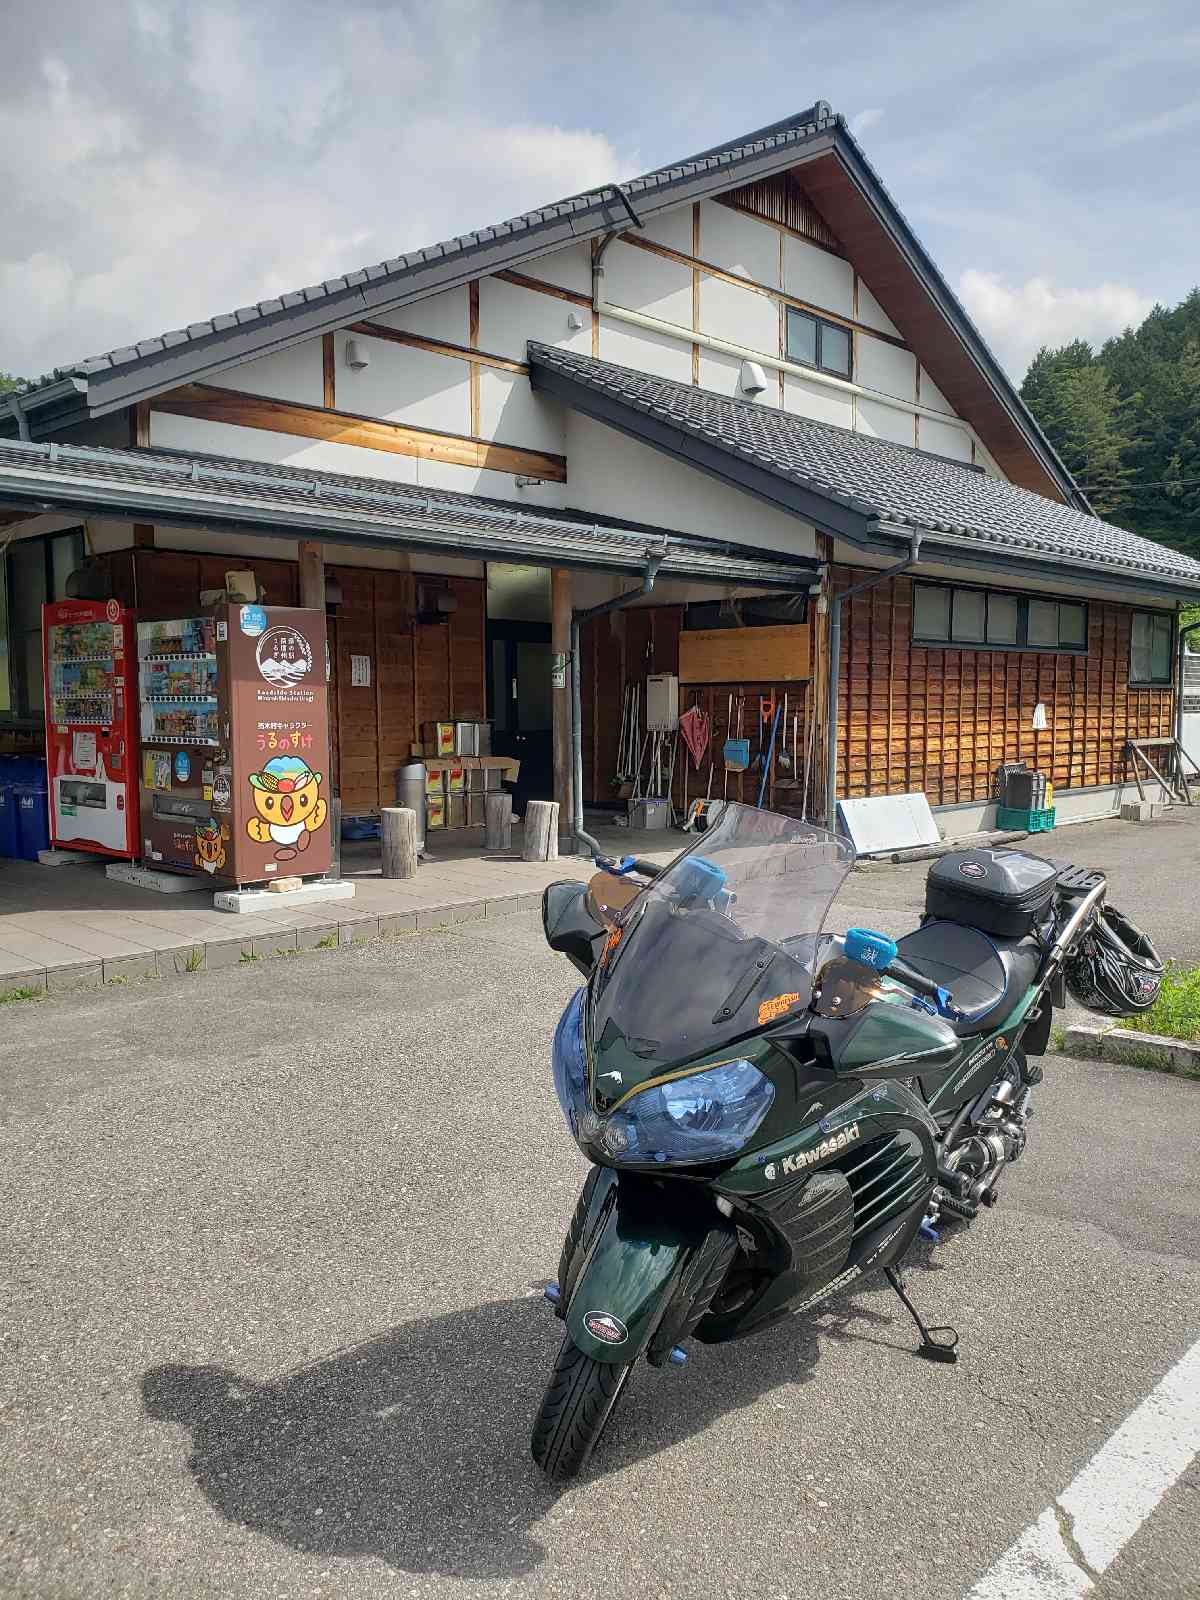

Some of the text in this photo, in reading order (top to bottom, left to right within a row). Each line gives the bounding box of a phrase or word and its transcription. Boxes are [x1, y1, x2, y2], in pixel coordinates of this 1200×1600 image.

[256, 731, 313, 751] うるのすけ
[781, 1121, 860, 1175] Kawasaki
